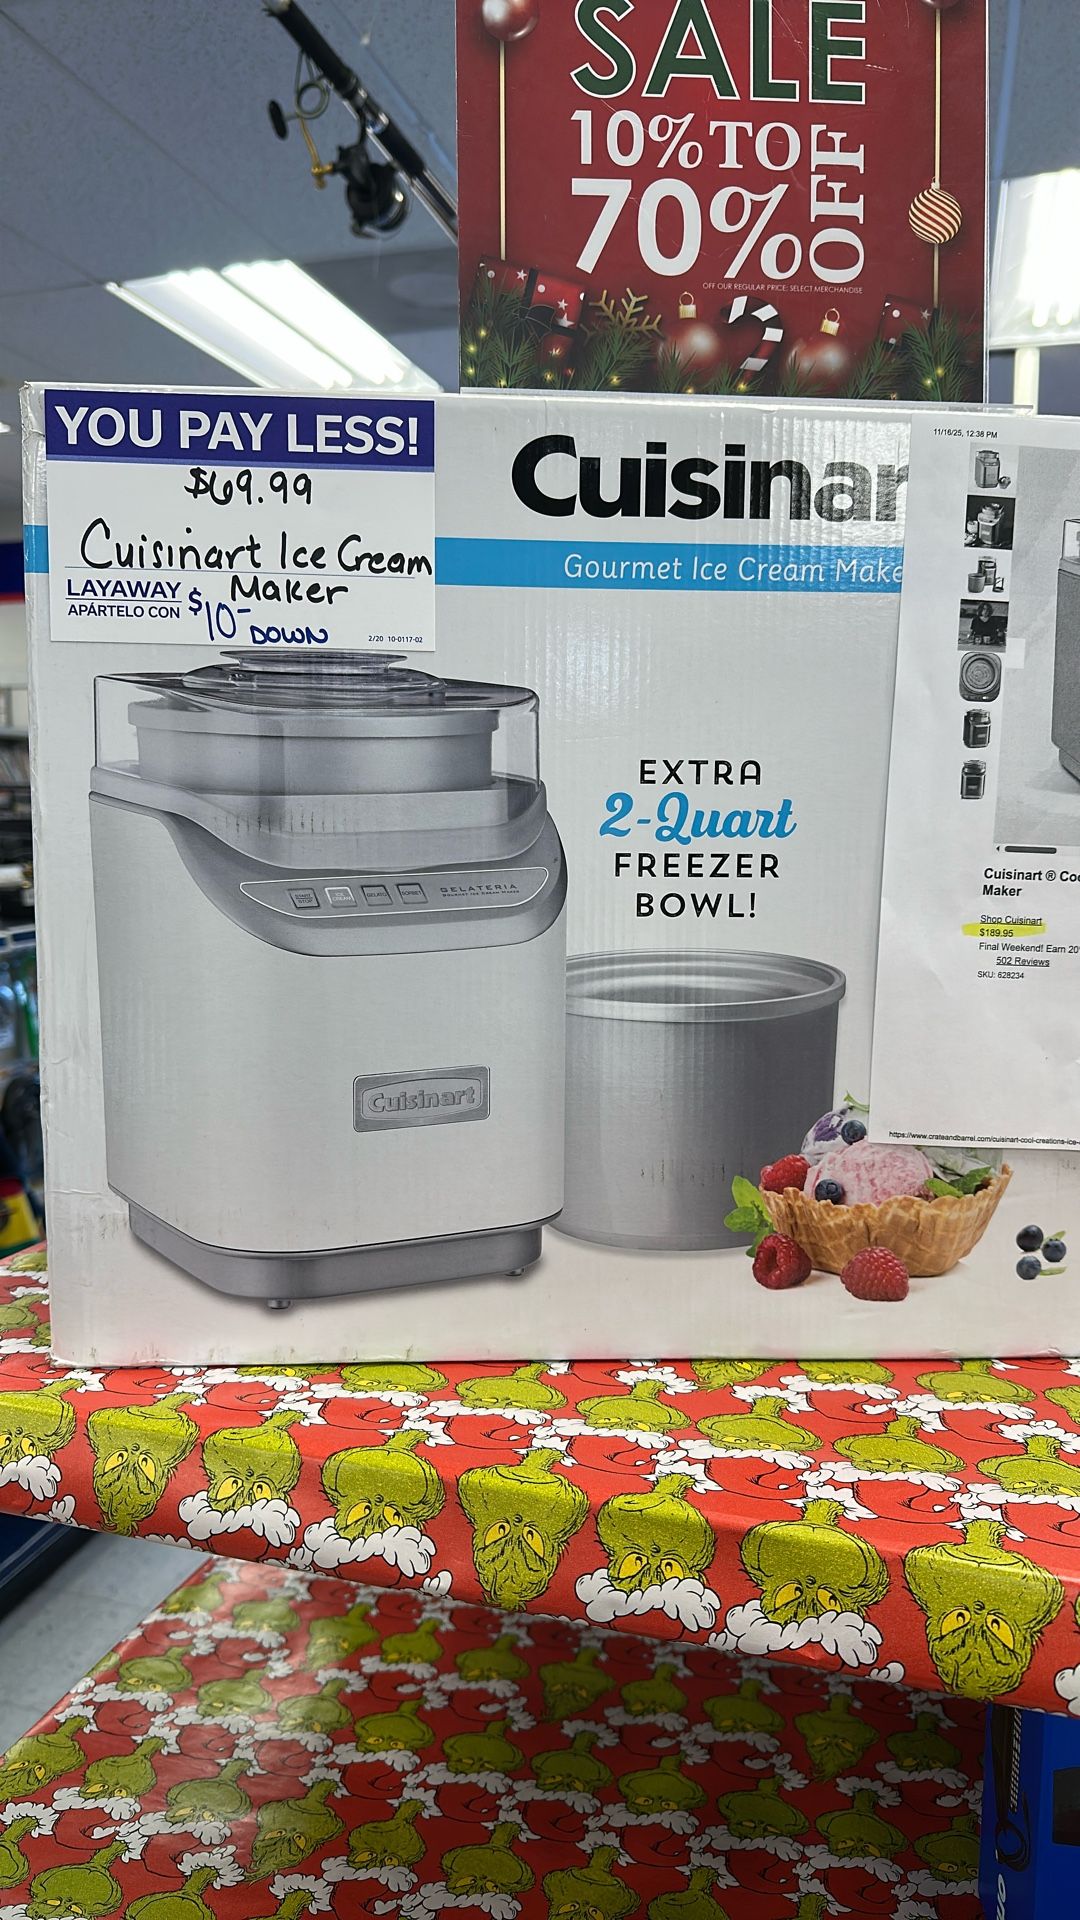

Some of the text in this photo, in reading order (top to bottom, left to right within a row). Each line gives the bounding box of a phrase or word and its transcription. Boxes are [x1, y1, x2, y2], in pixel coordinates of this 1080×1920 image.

[570, 0, 866, 105] SALE
[570, 110, 801, 171] 10% TO
[809, 124, 866, 284] OFF
[570, 178, 802, 280] 70%
[702, 282, 717, 290] OFF
[733, 283, 765, 292] REGULAR
[789, 285, 813, 293] SELECT
[814, 286, 863, 294] MERCHANDISE
[55, 406, 418, 456] YOU PAY LESS!
[934, 428, 964, 437] 11/16/25,
[184, 467, 313, 505] $69.99
[511, 434, 910, 523] Cuisinar
[80, 518, 433, 576] Cuisinart Ice Cream
[564, 553, 902, 583] Gourmet Ice Cream Make
[67, 579, 182, 598] LAYAWAY
[230, 575, 350, 604] Maker
[68, 603, 180, 619] APÁRTELO CON
[250, 625, 328, 644] DOWN
[388, 635, 423, 643] 10-0117-02
[640, 759, 761, 785] EXTRA
[599, 791, 797, 845] 2-Quart
[614, 852, 779, 878] FREEZER
[984, 868, 1043, 881] Cuisinart
[440, 884, 517, 893] GELATERIA
[982, 884, 1022, 896] Maker
[636, 892, 756, 918] BOWL!
[979, 928, 1014, 937] $189.95
[980, 914, 1043, 925] Shop Cuisinart
[979, 942, 999, 951] Final
[1001, 942, 1044, 952] Weekend!
[1046, 944, 1066, 953] Earn
[977, 970, 1024, 979] SKU: 628234
[996, 956, 1050, 967] 502 Reviews
[368, 1086, 475, 1112] Cuisinart
